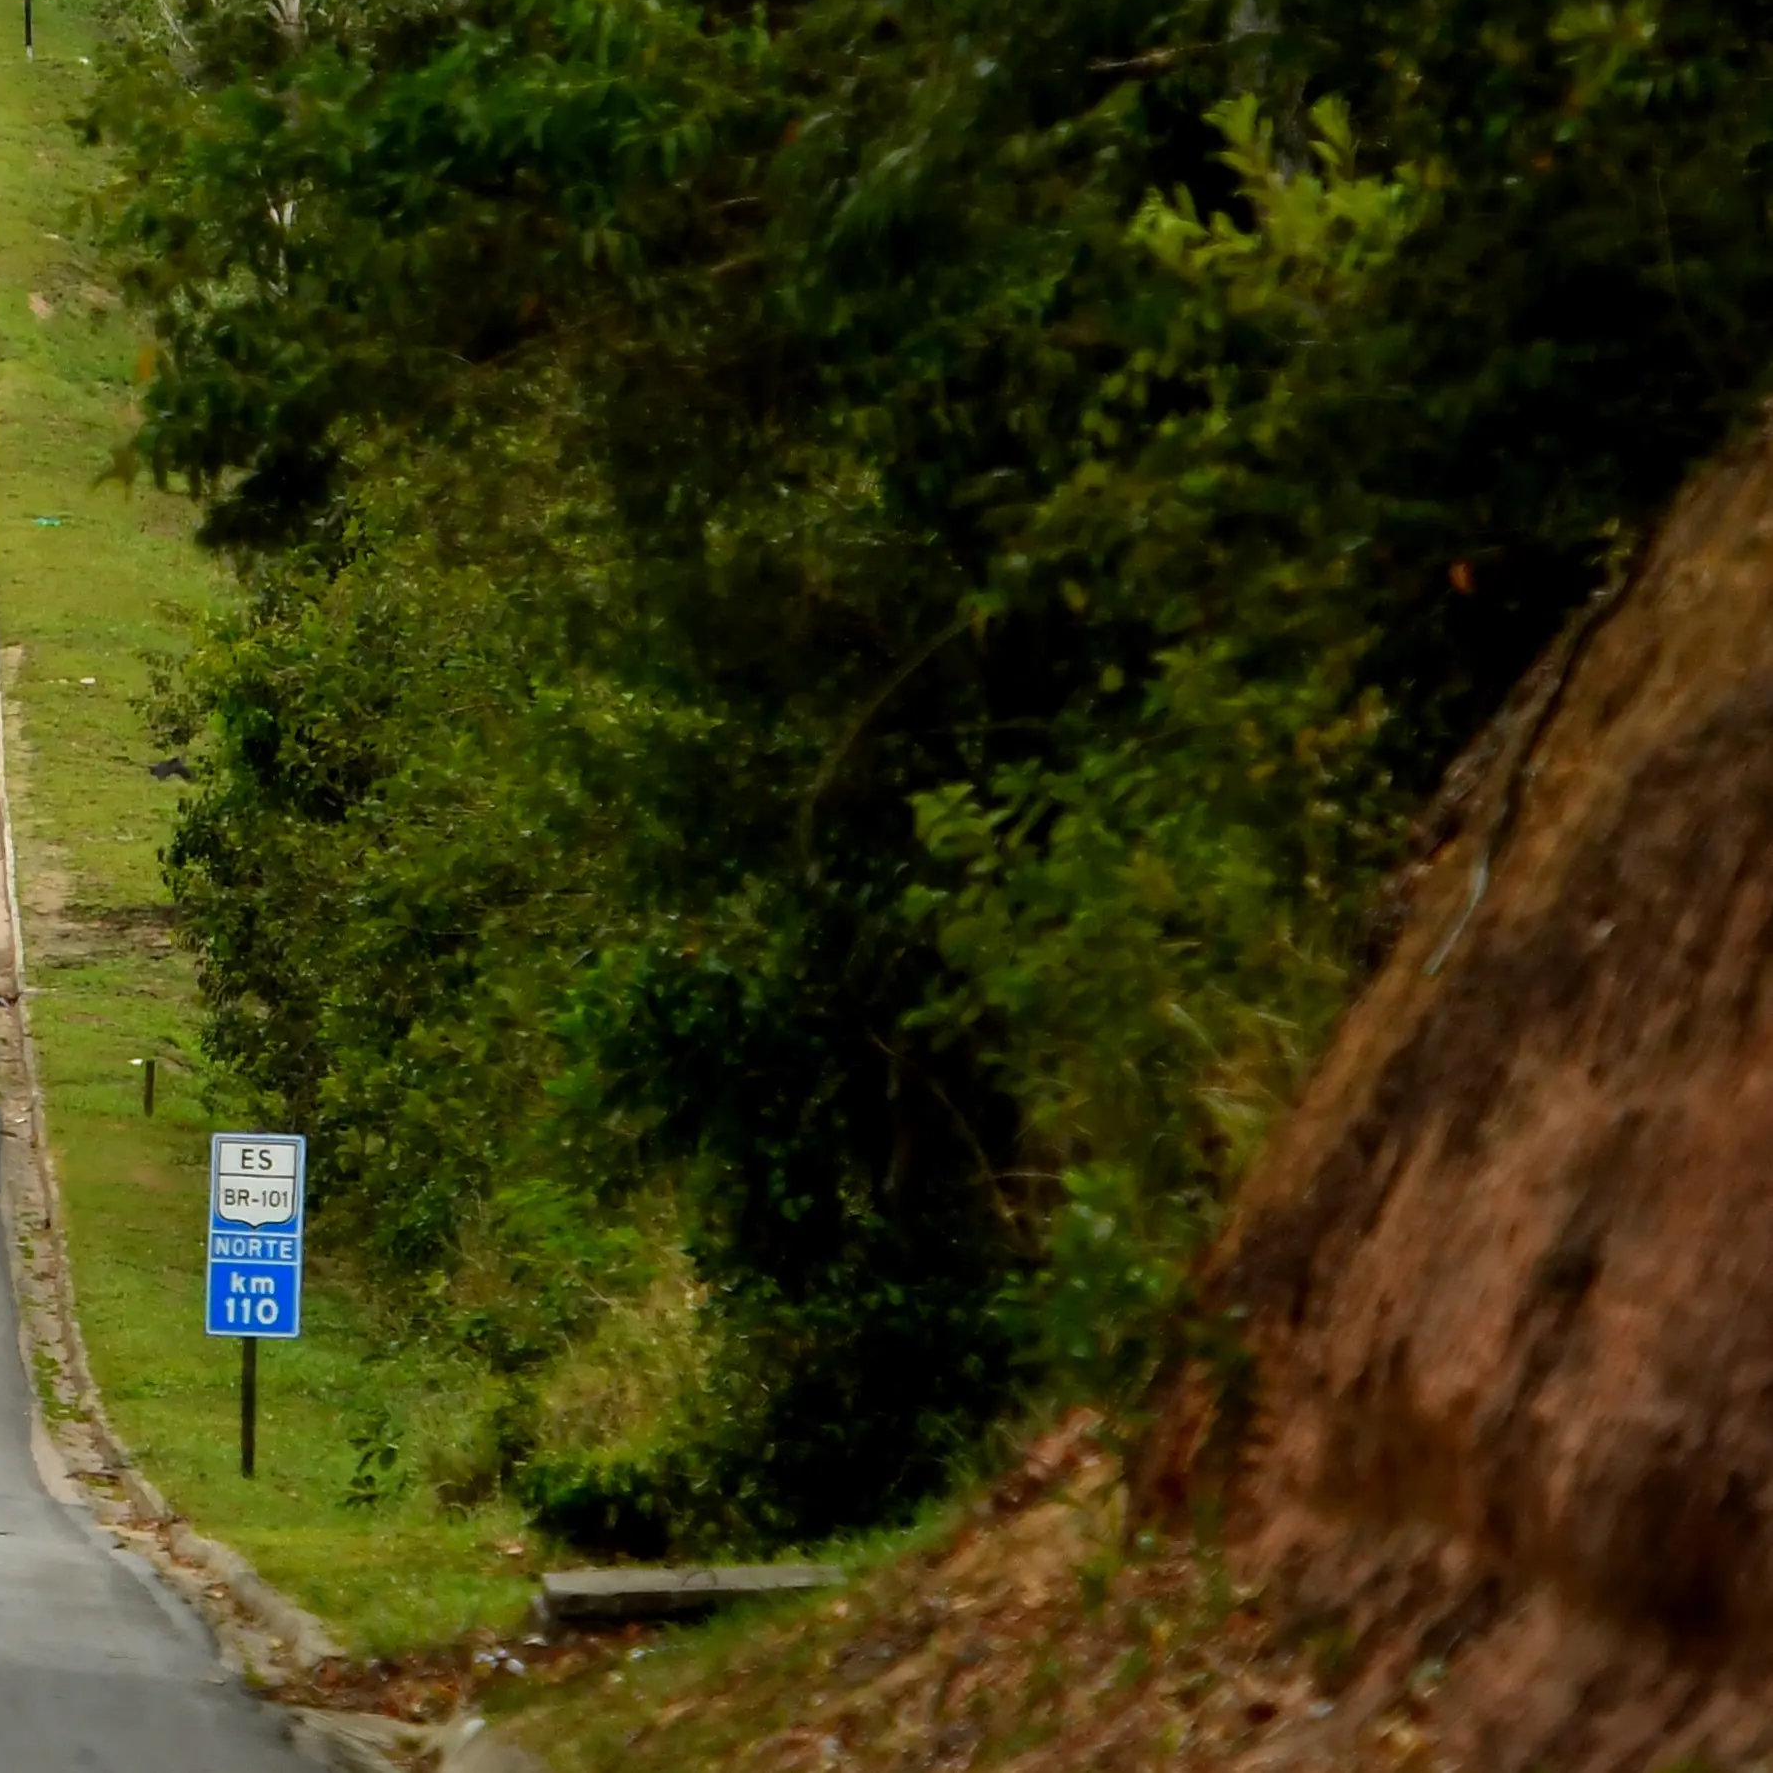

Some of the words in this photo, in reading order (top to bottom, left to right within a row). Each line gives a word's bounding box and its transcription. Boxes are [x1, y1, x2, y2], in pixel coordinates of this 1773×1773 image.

[241, 1148, 273, 1170] ES
[223, 1188, 289, 1208] BR-101
[214, 1237, 294, 1260] NORTE
[230, 1272, 276, 1295] km
[225, 1297, 280, 1325] 110
